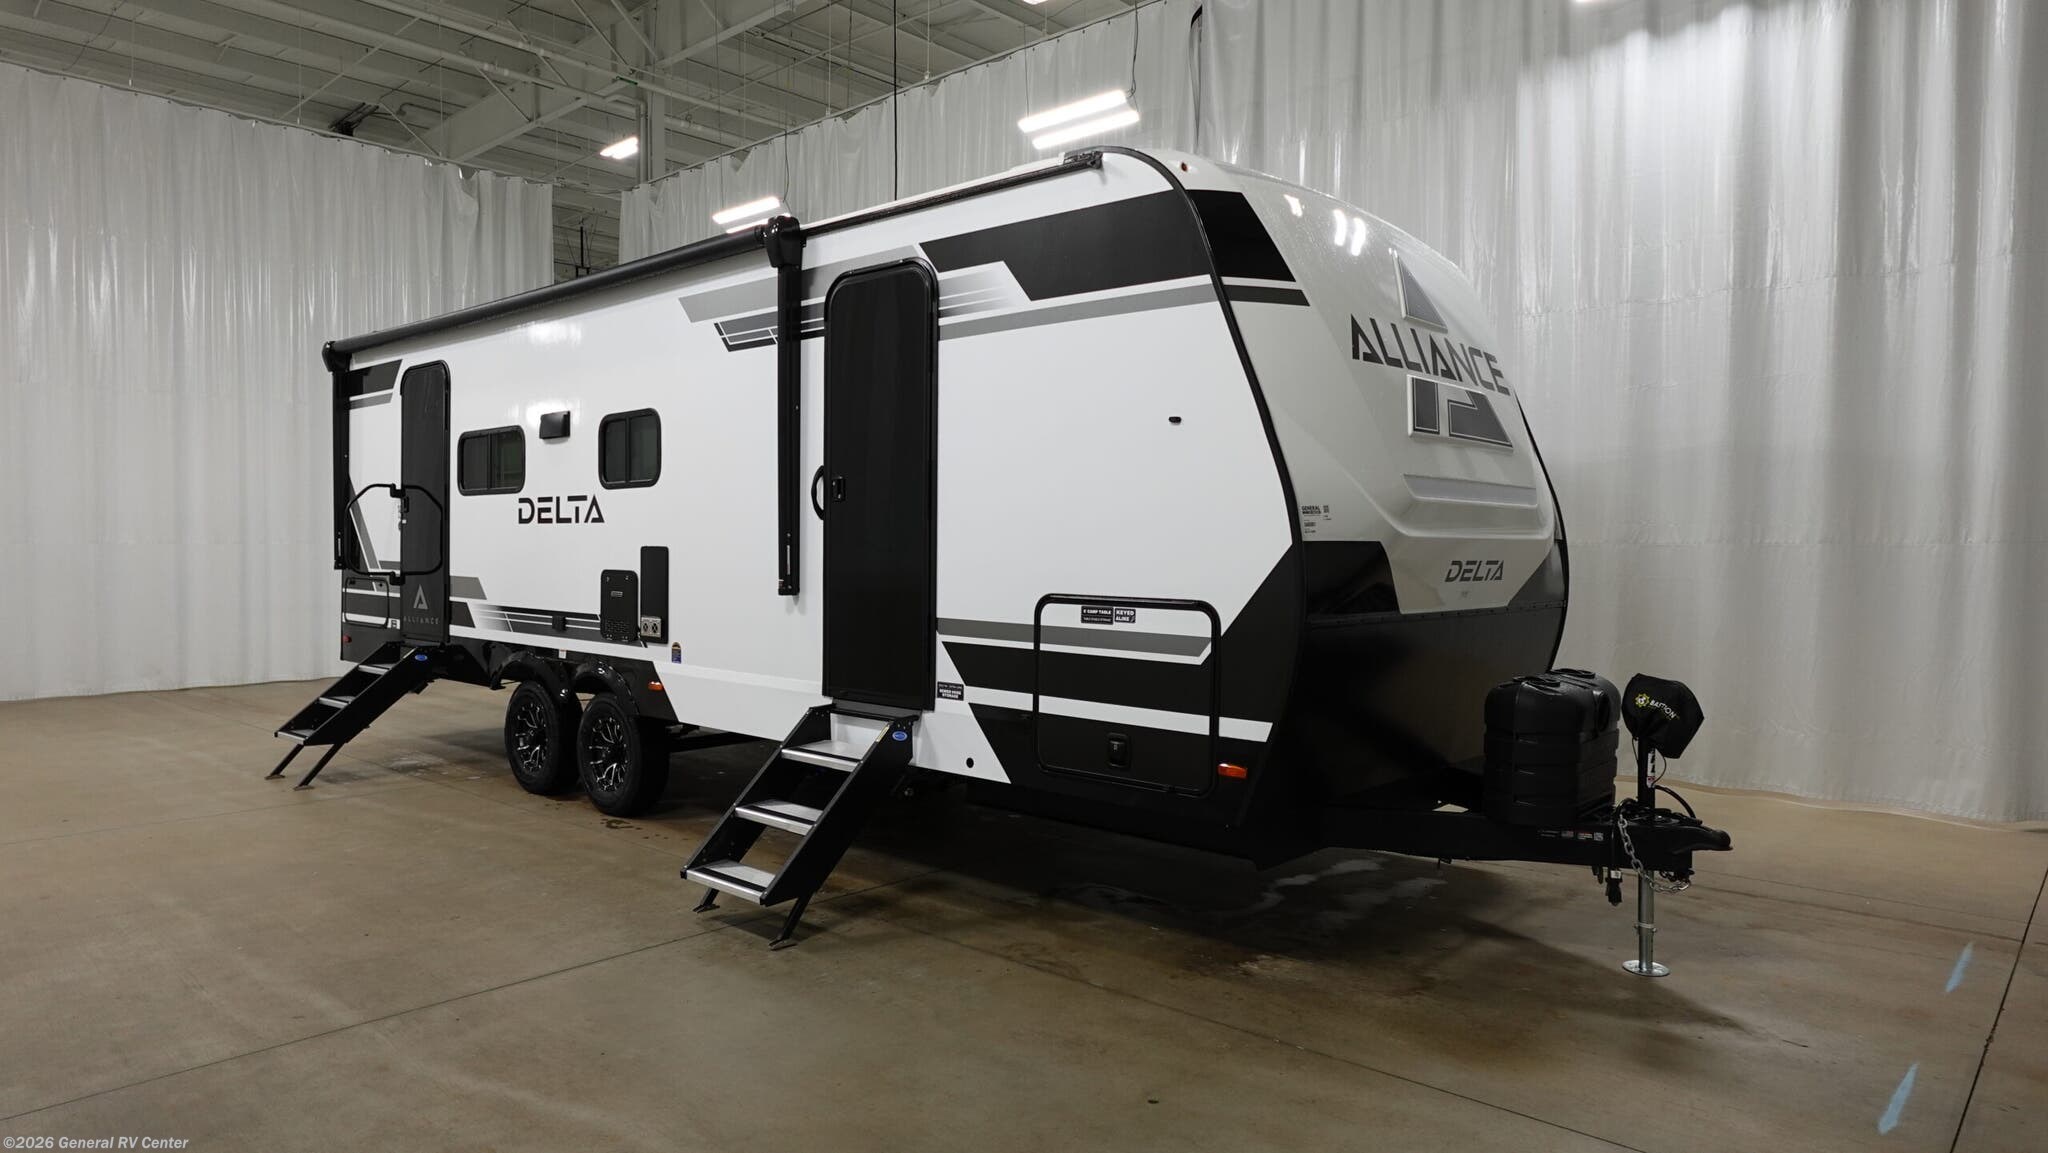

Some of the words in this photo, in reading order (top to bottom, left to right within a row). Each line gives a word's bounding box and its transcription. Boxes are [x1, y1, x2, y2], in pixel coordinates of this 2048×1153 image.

[1350, 313, 1511, 396] ALLIANCE
[518, 493, 606, 525] DELTA
[1444, 560, 1504, 582] DELTA
[403, 616, 439, 625] ALLIANCE
[1649, 699, 1677, 719] BASTION
